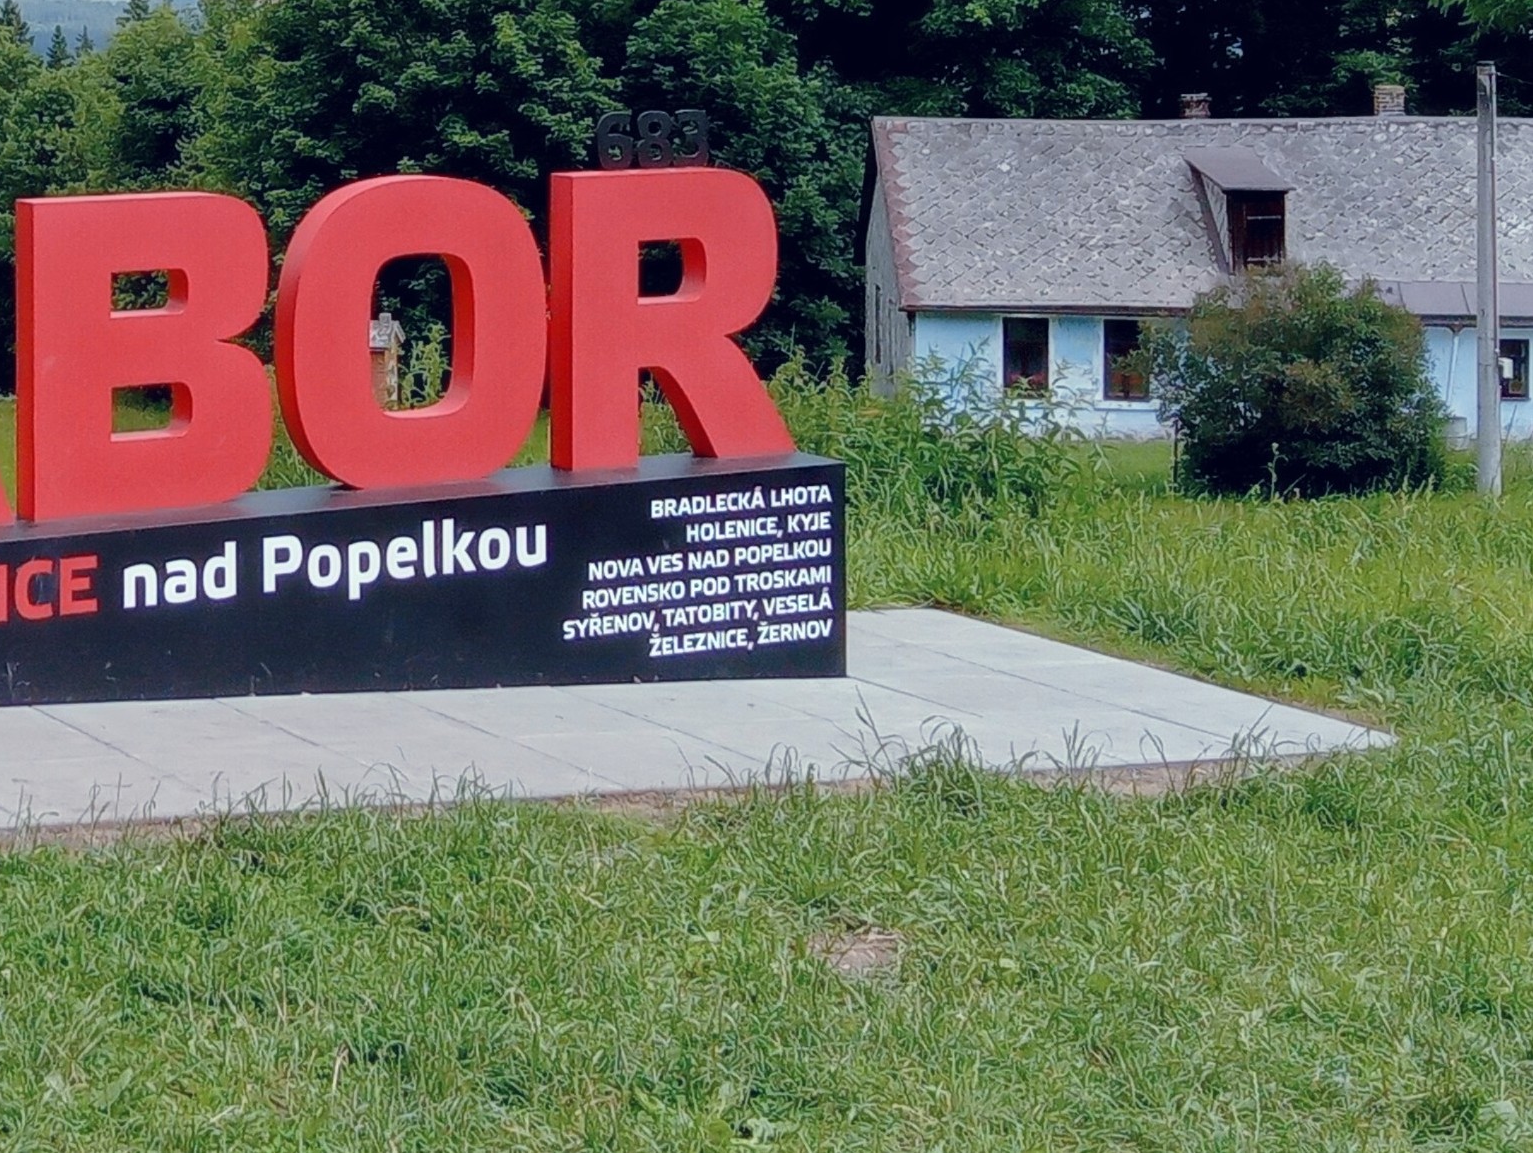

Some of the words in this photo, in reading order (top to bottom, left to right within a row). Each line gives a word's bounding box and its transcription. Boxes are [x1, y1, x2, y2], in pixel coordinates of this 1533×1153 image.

[596, 108, 709, 169] 683
[651, 487, 765, 519] BRADLECKÁ
[770, 485, 832, 507] LHOTA
[686, 517, 784, 544] HOLENICE,
[787, 511, 831, 533] KYJE
[122, 542, 237, 610] nad
[262, 518, 548, 600] Popelkou
[647, 553, 683, 574] VES
[688, 549, 729, 571] NAD
[734, 538, 831, 566] POPELKOU
[582, 580, 685, 610] ROVENSKO
[690, 576, 730, 598] POD
[734, 565, 831, 593] TROSKAMI
[563, 610, 660, 640] SYŘENOV,
[663, 599, 759, 628] TATOBITY,
[762, 588, 833, 617] VESELÁ
[649, 628, 754, 658] ŽELEZNICE,
[757, 619, 833, 644] ŽERNOV
